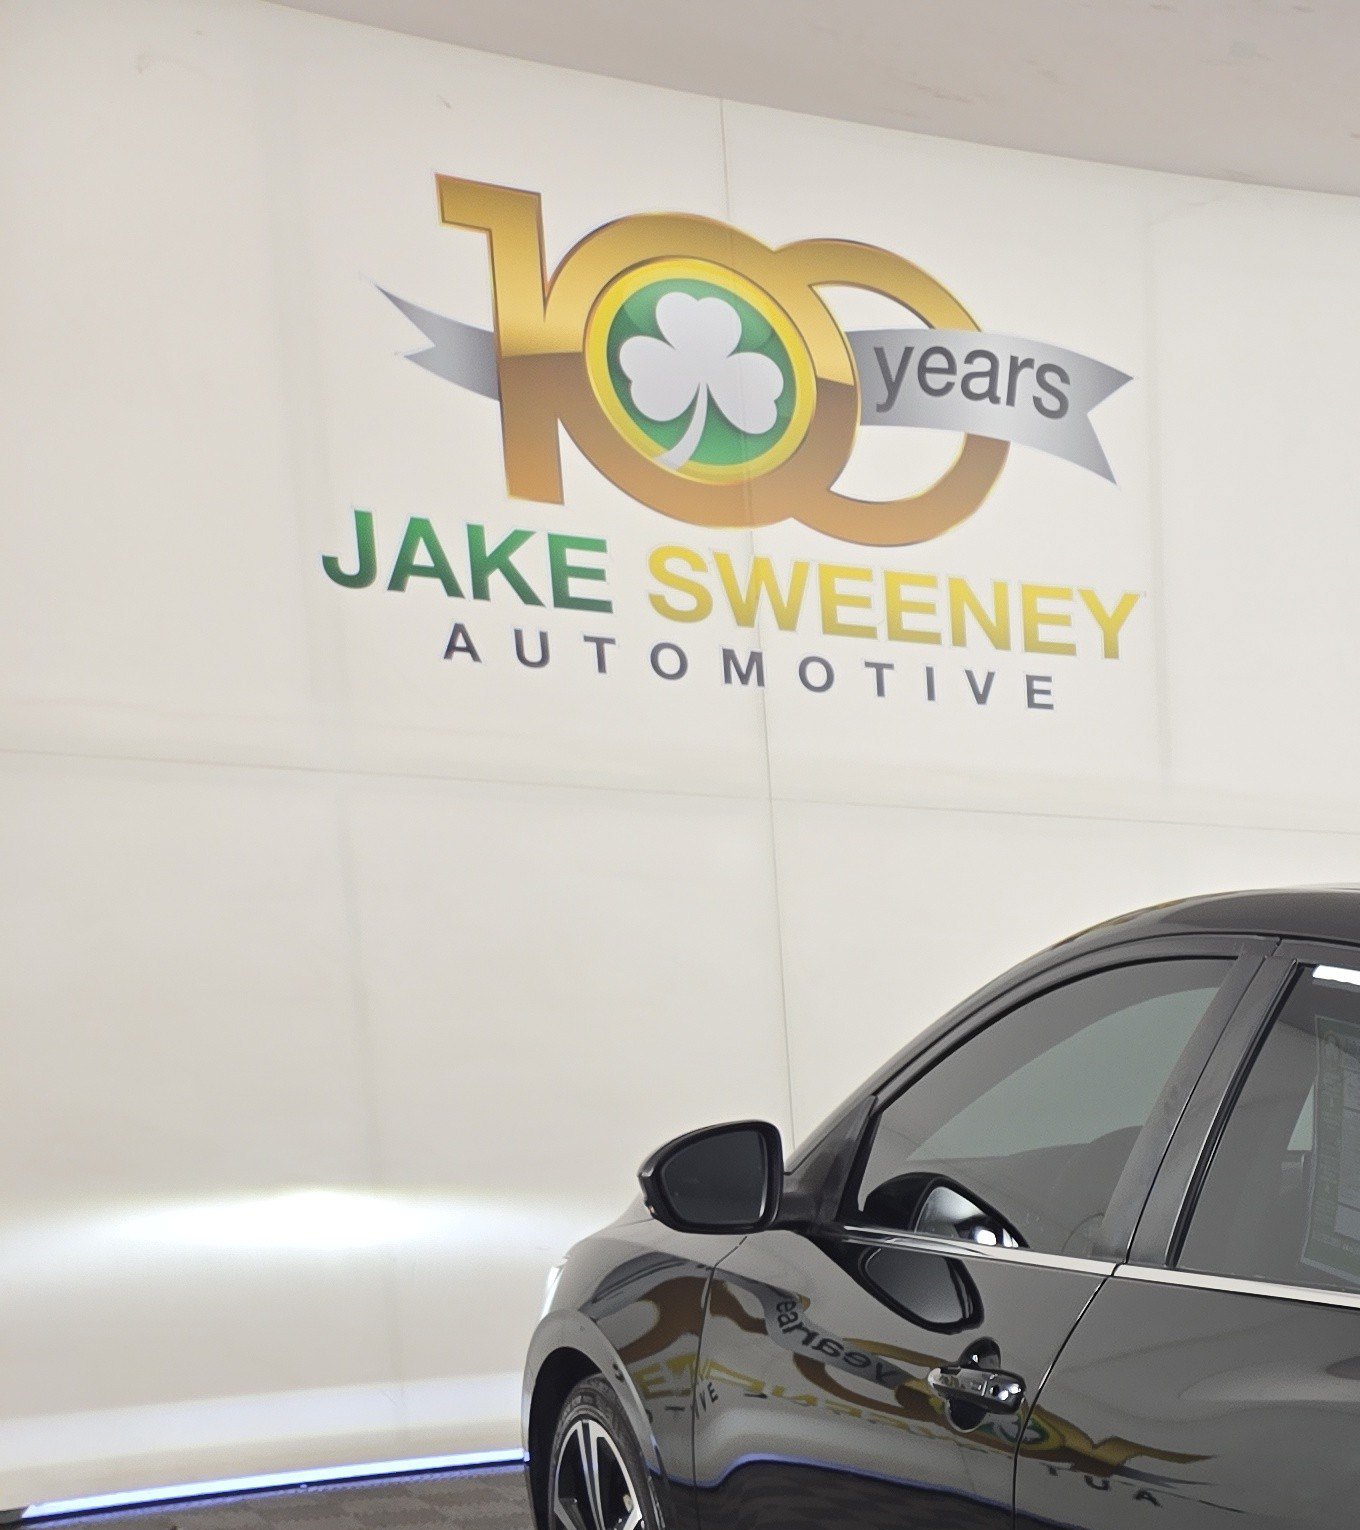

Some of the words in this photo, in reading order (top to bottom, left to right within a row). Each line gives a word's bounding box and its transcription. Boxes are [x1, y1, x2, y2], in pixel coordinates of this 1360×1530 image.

[435, 173, 1011, 548] 100
[873, 344, 1072, 420] years
[321, 509, 614, 614] JAKE
[648, 544, 1141, 660] SWEENEY
[442, 621, 1056, 711] AUTOMOTIVE
